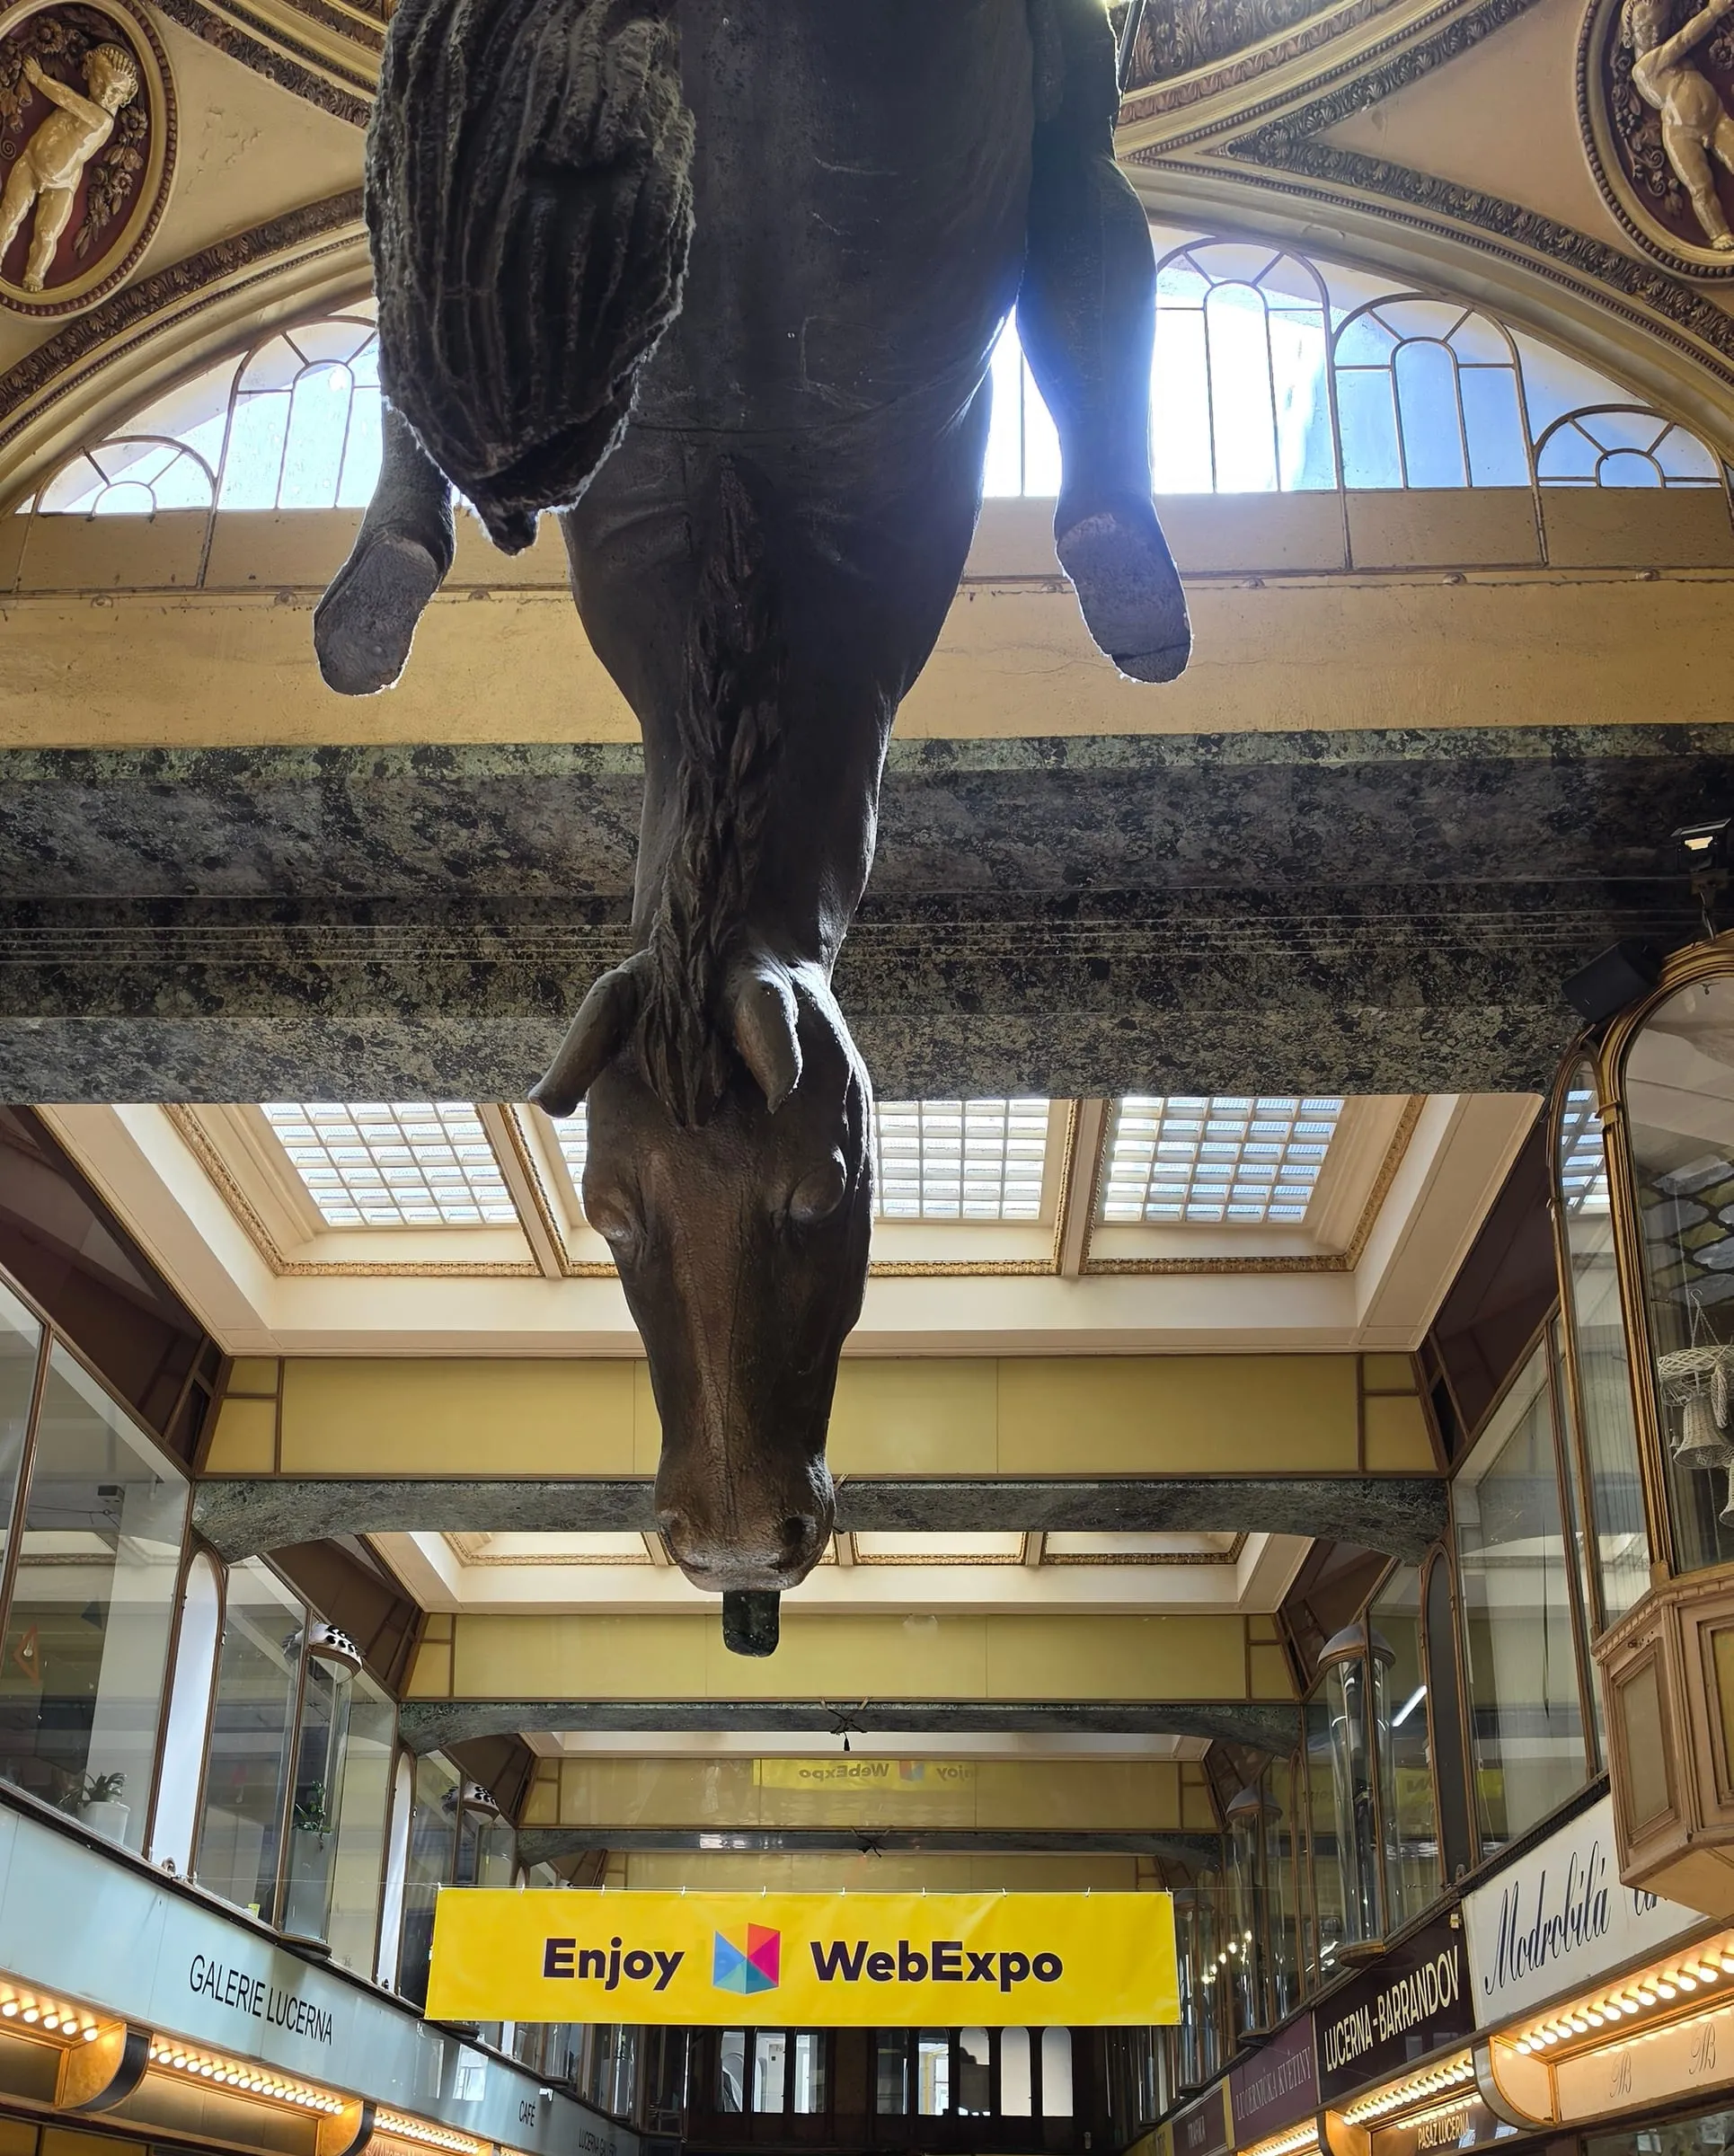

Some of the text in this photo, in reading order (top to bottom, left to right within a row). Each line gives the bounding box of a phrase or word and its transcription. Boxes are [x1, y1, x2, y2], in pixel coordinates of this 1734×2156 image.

[543, 1936, 1064, 1993] Enjoy WebExpo
[190, 1954, 333, 2046] GALERIE LUCERNA
[518, 2100, 536, 2127] CAFÉ
[1438, 2111, 1471, 2144] LUCERNA
